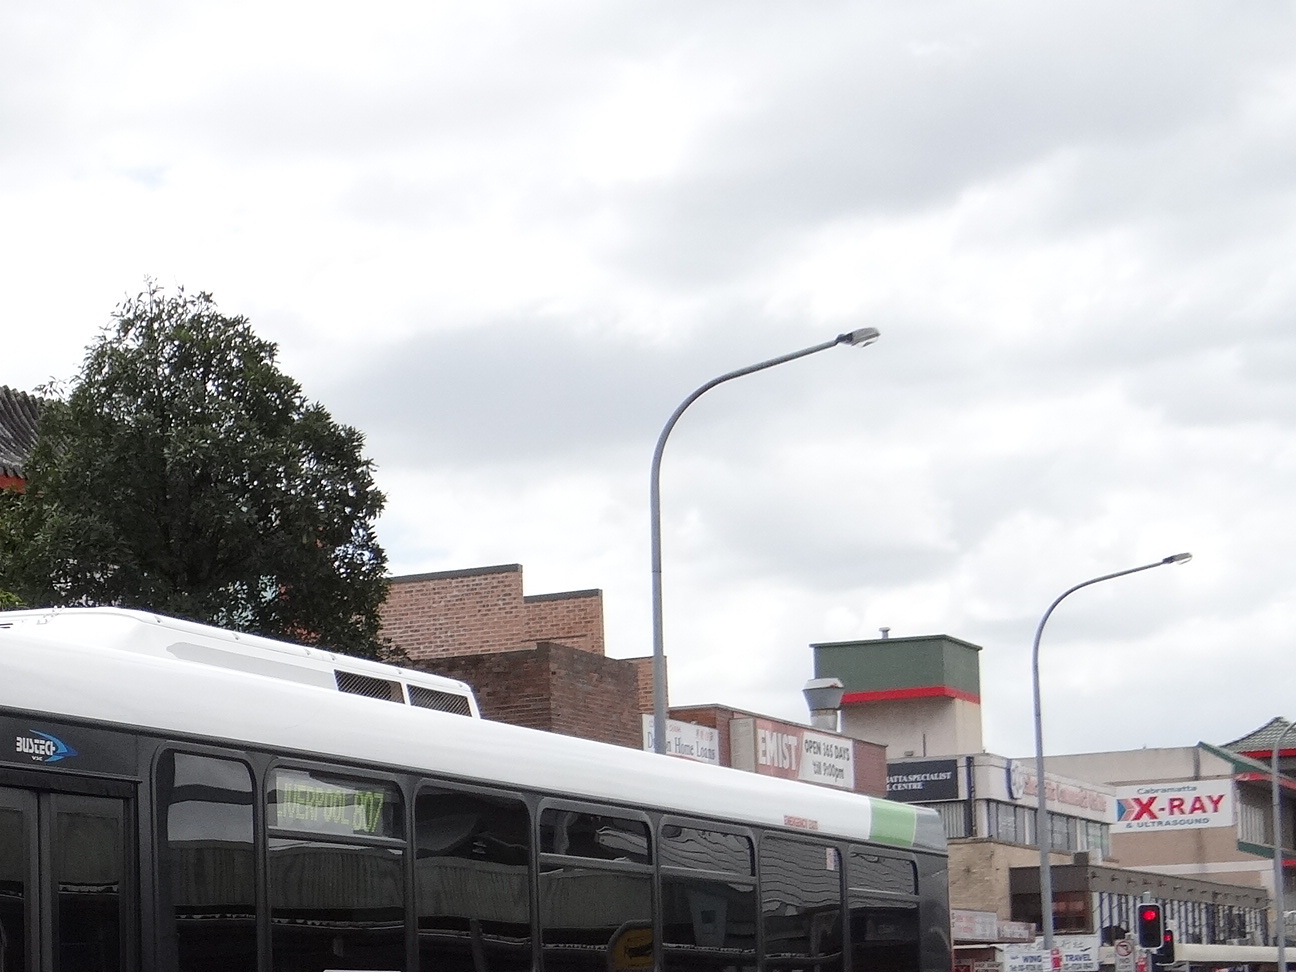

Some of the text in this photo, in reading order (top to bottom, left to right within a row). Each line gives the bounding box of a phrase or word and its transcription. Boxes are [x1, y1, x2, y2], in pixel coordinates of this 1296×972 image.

[804, 739, 821, 755] OPEN
[834, 745, 850, 762] DAYS
[908, 771, 952, 782] SPECIALIST
[892, 782, 923, 791] CENTRE
[1136, 785, 1198, 795] Cabramatta
[1131, 793, 1225, 821] X-RAY
[1137, 818, 1210, 828] ULTRASOUND
[1065, 953, 1092, 961] TRAVEL
